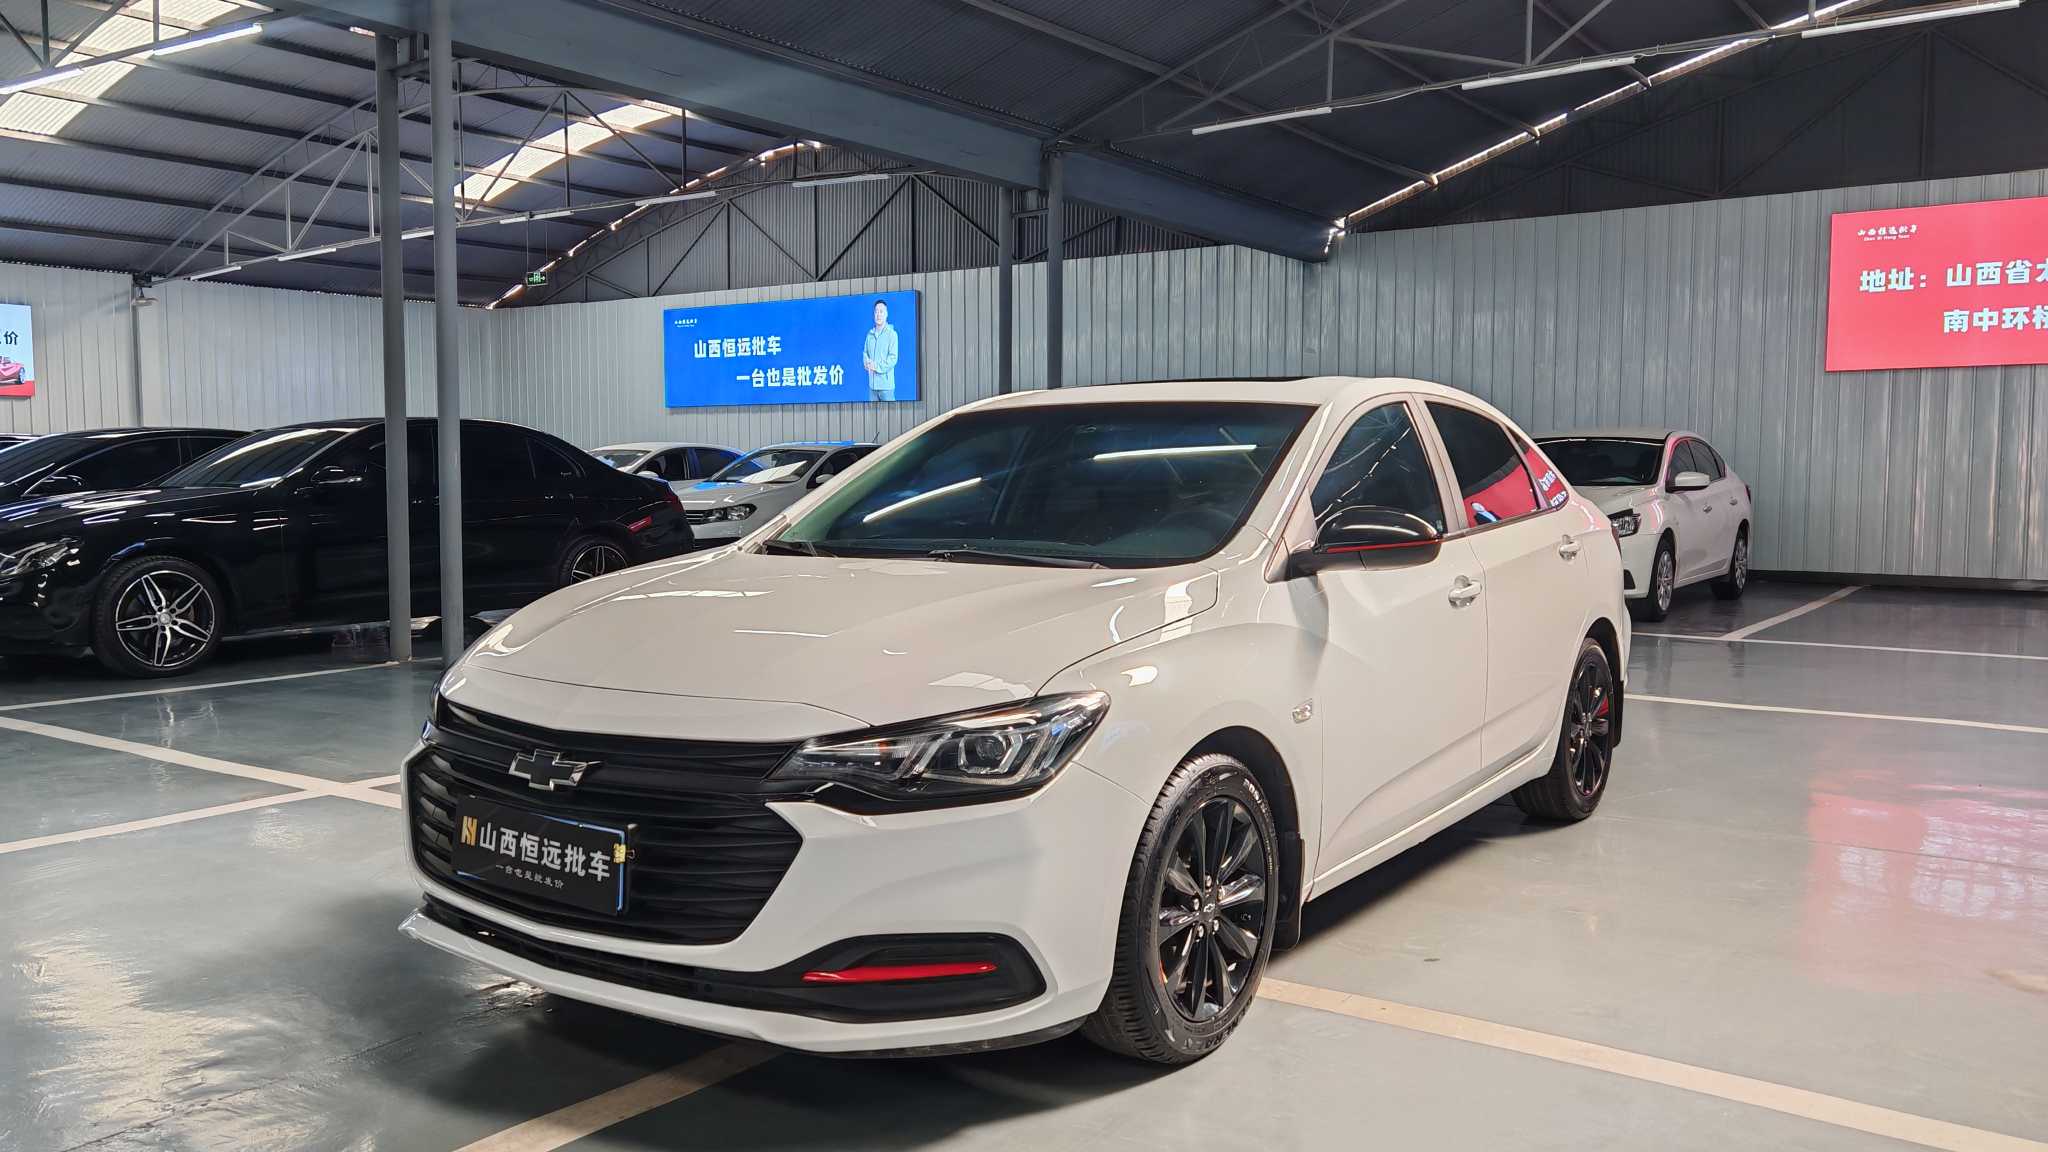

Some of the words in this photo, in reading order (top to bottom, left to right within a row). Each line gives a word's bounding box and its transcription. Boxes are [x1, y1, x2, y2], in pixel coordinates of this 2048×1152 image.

[0, 331, 19, 346] 价
[694, 335, 782, 359] 山西恒远批车
[736, 364, 844, 388] 一台也是批发价
[479, 822, 611, 882] 山西恒远批车
[495, 864, 565, 889] 一台也是批发价
